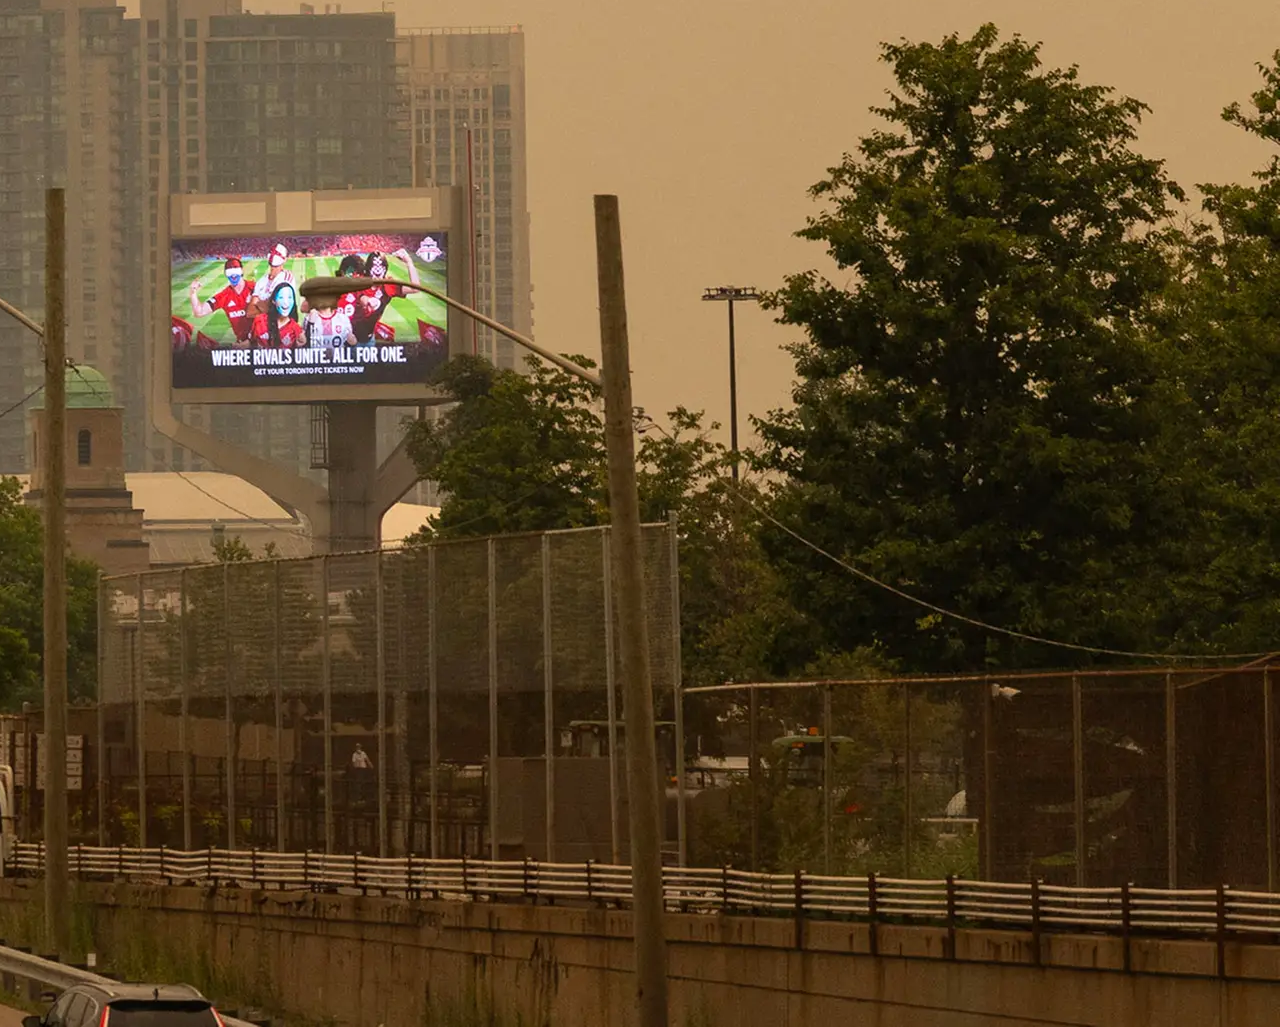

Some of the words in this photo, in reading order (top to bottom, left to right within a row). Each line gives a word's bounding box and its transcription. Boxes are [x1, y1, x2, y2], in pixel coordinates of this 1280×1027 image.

[211, 349, 251, 367] WHERE
[253, 348, 292, 366] RIVALS
[294, 348, 330, 365] UNITE.
[332, 347, 354, 364] ALL
[356, 346, 378, 363] FOR
[380, 346, 407, 362] ONE.
[285, 367, 314, 375] TORONTO
[323, 366, 348, 374] TICKETS
